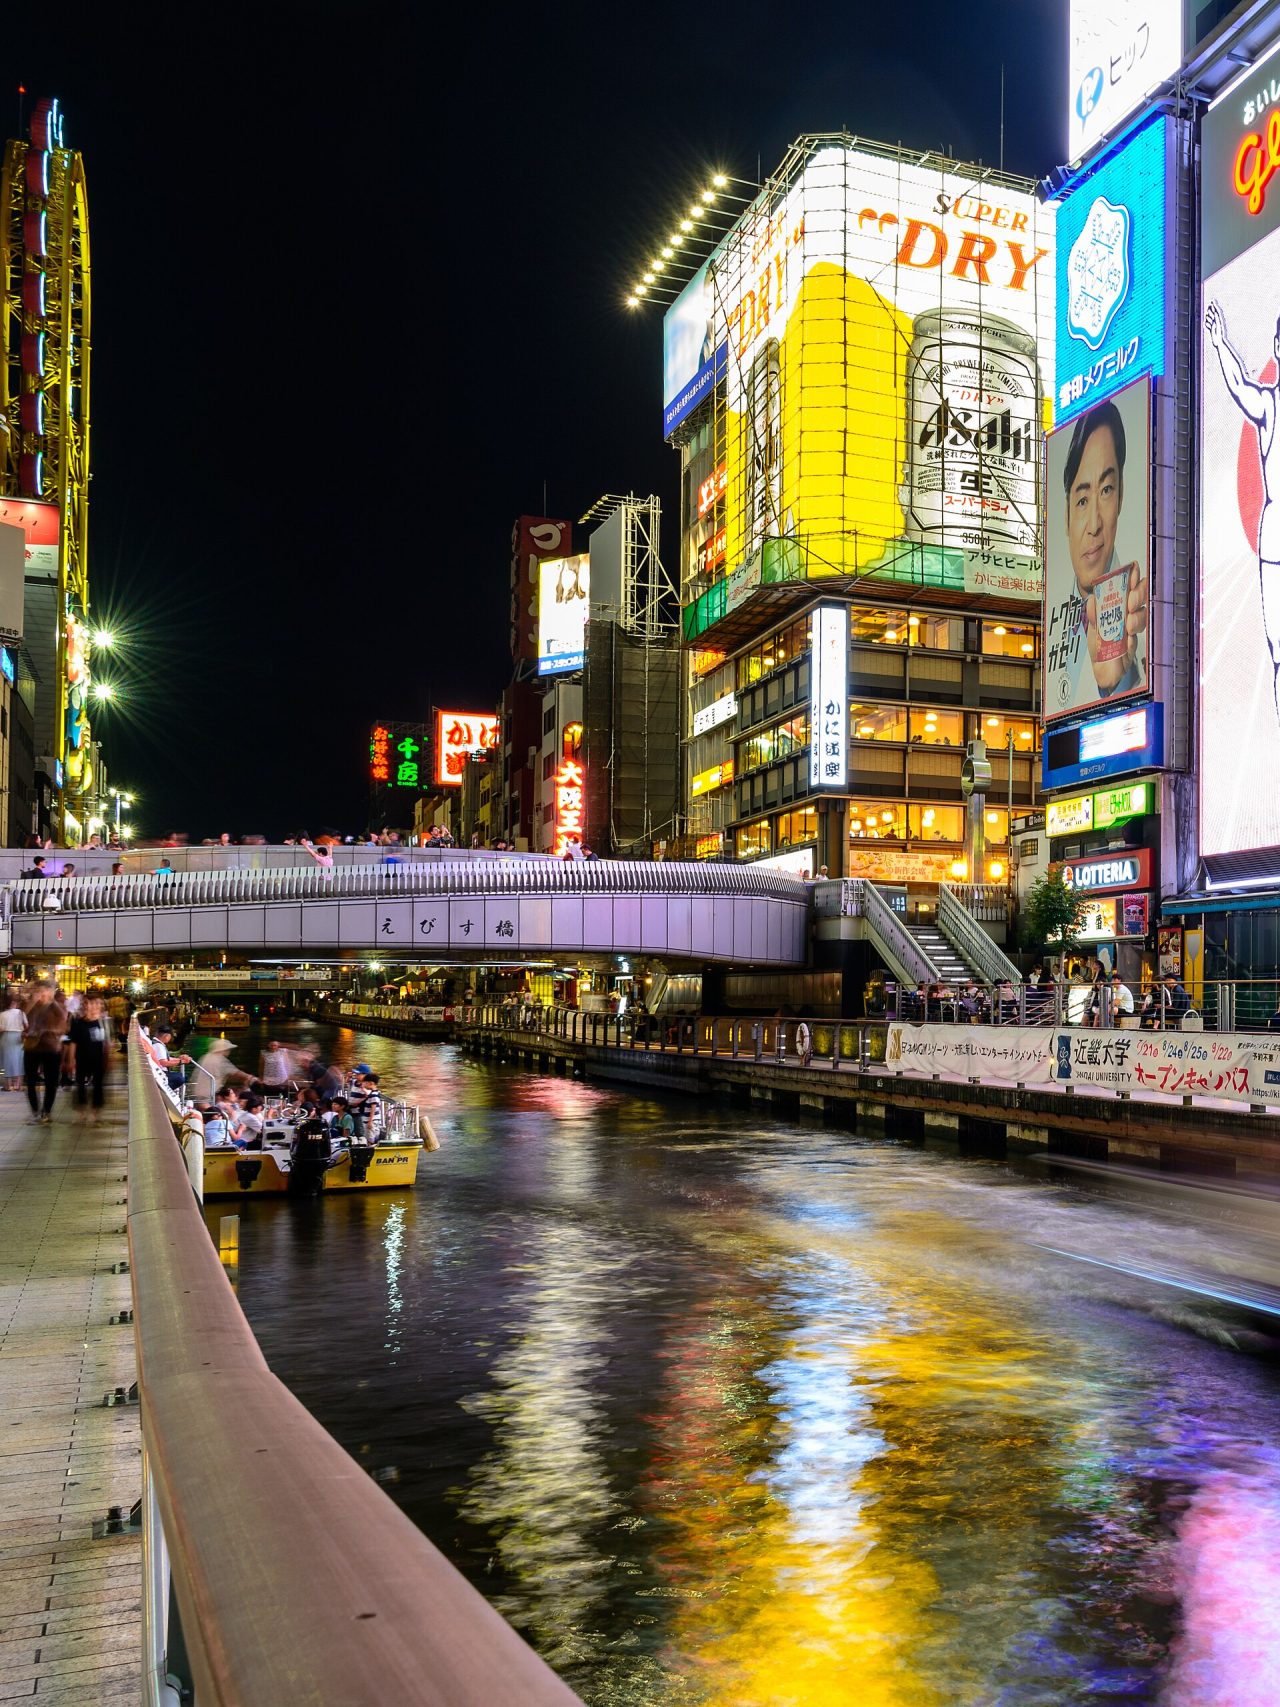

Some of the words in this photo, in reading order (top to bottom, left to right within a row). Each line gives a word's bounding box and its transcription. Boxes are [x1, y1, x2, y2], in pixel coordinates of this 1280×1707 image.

[933, 193, 1029, 233] SUPER
[1059, 335, 1140, 409] 雪印メグミルク
[918, 397, 1033, 465] Asahi
[959, 469, 994, 495] 生
[944, 495, 1009, 515] スーパードライ
[967, 549, 1041, 571] アサヒビール
[396, 736, 420, 781] 千房
[1075, 860, 1133, 887] LOTTERIA
[380, 917, 514, 938] えびす橋
[1073, 1038, 1132, 1067] 近畿大学
[1095, 1071, 1132, 1083] UNIVERSITY
